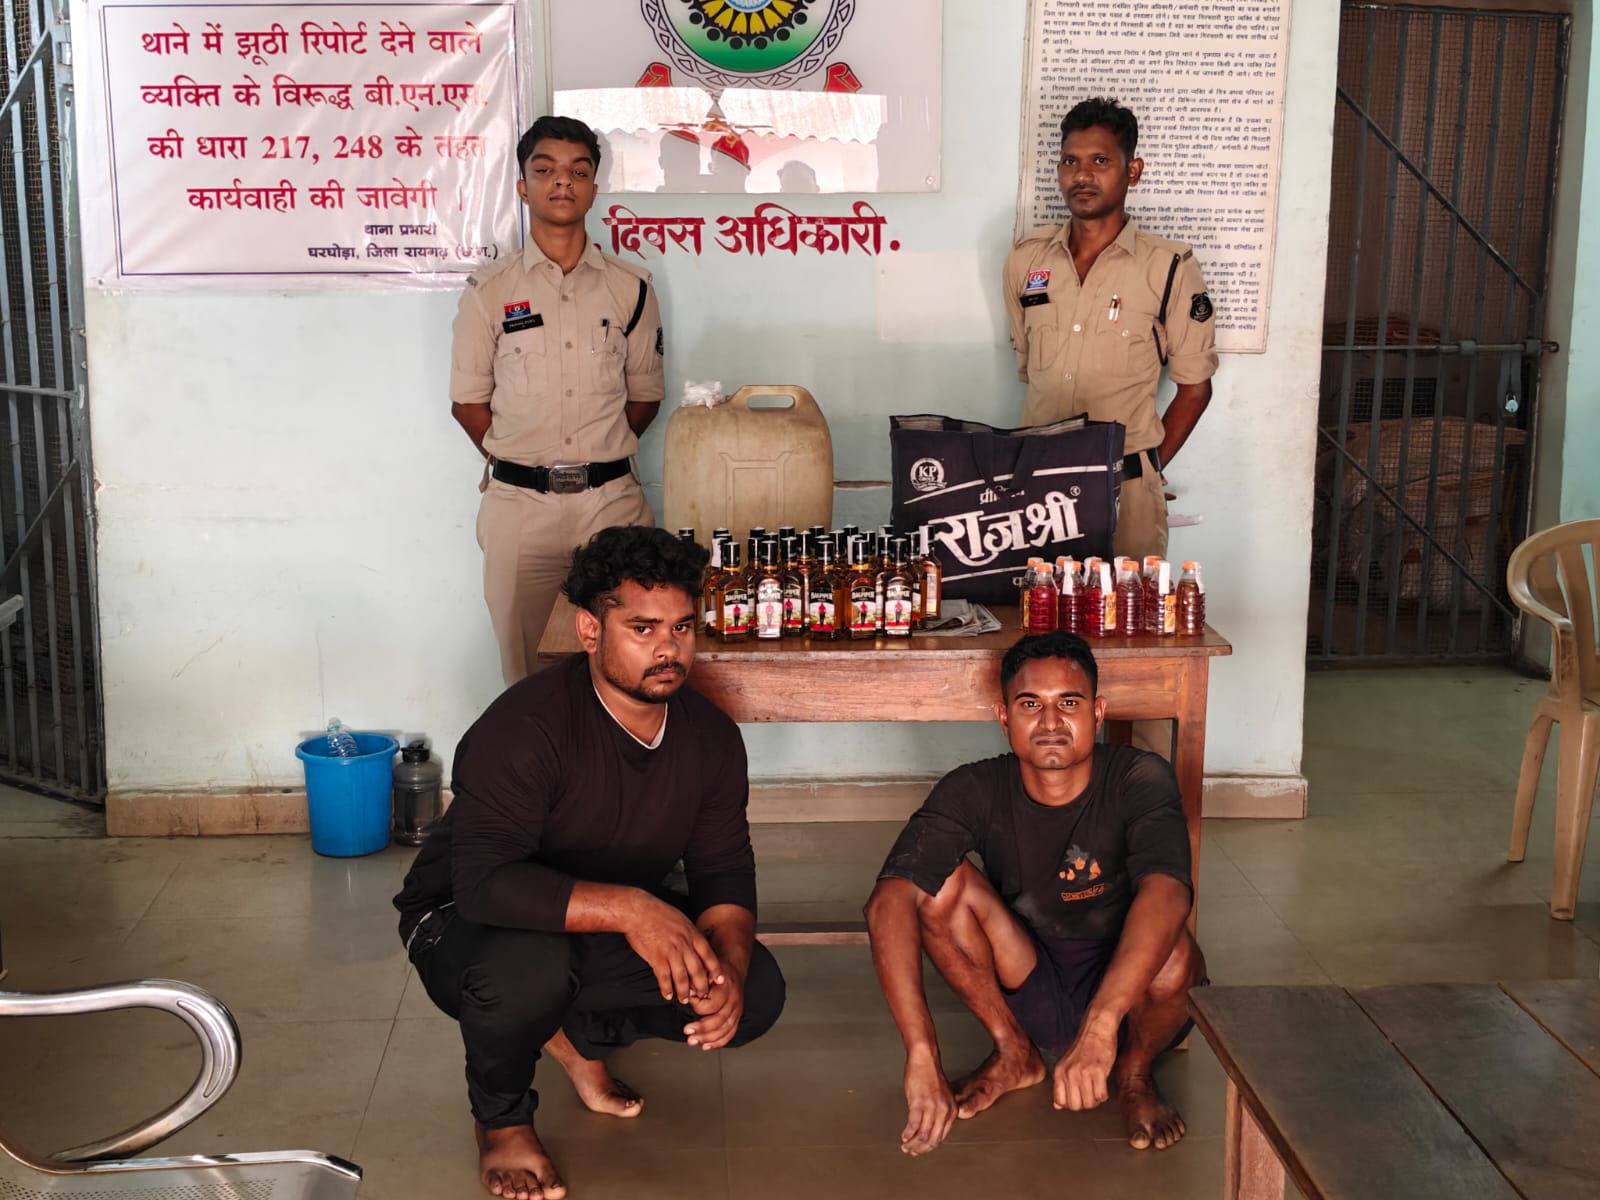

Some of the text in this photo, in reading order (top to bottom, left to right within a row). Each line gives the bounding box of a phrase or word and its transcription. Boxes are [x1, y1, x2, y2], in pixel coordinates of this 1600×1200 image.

[141, 20, 483, 65] थाने में झूठी रिपोर्ट देने वाले
[140, 74, 221, 107] व्यक्ति
[232, 74, 261, 107] के
[363, 74, 488, 112] बी.एन.एस.
[146, 125, 487, 165] की धारा 217, 248 के तहत
[187, 178, 298, 211] कार्यवाही
[308, 177, 345, 209] की
[356, 177, 437, 211] जावेगी
[364, 222, 437, 236] थाना प्रभारी
[603, 205, 705, 259] दिवस
[308, 243, 360, 261] घरघोड़ा,
[366, 242, 398, 258] जिला
[404, 246, 448, 260] रायगढ़
[919, 465, 937, 478] KP
[923, 491, 1085, 567] राजश्री
